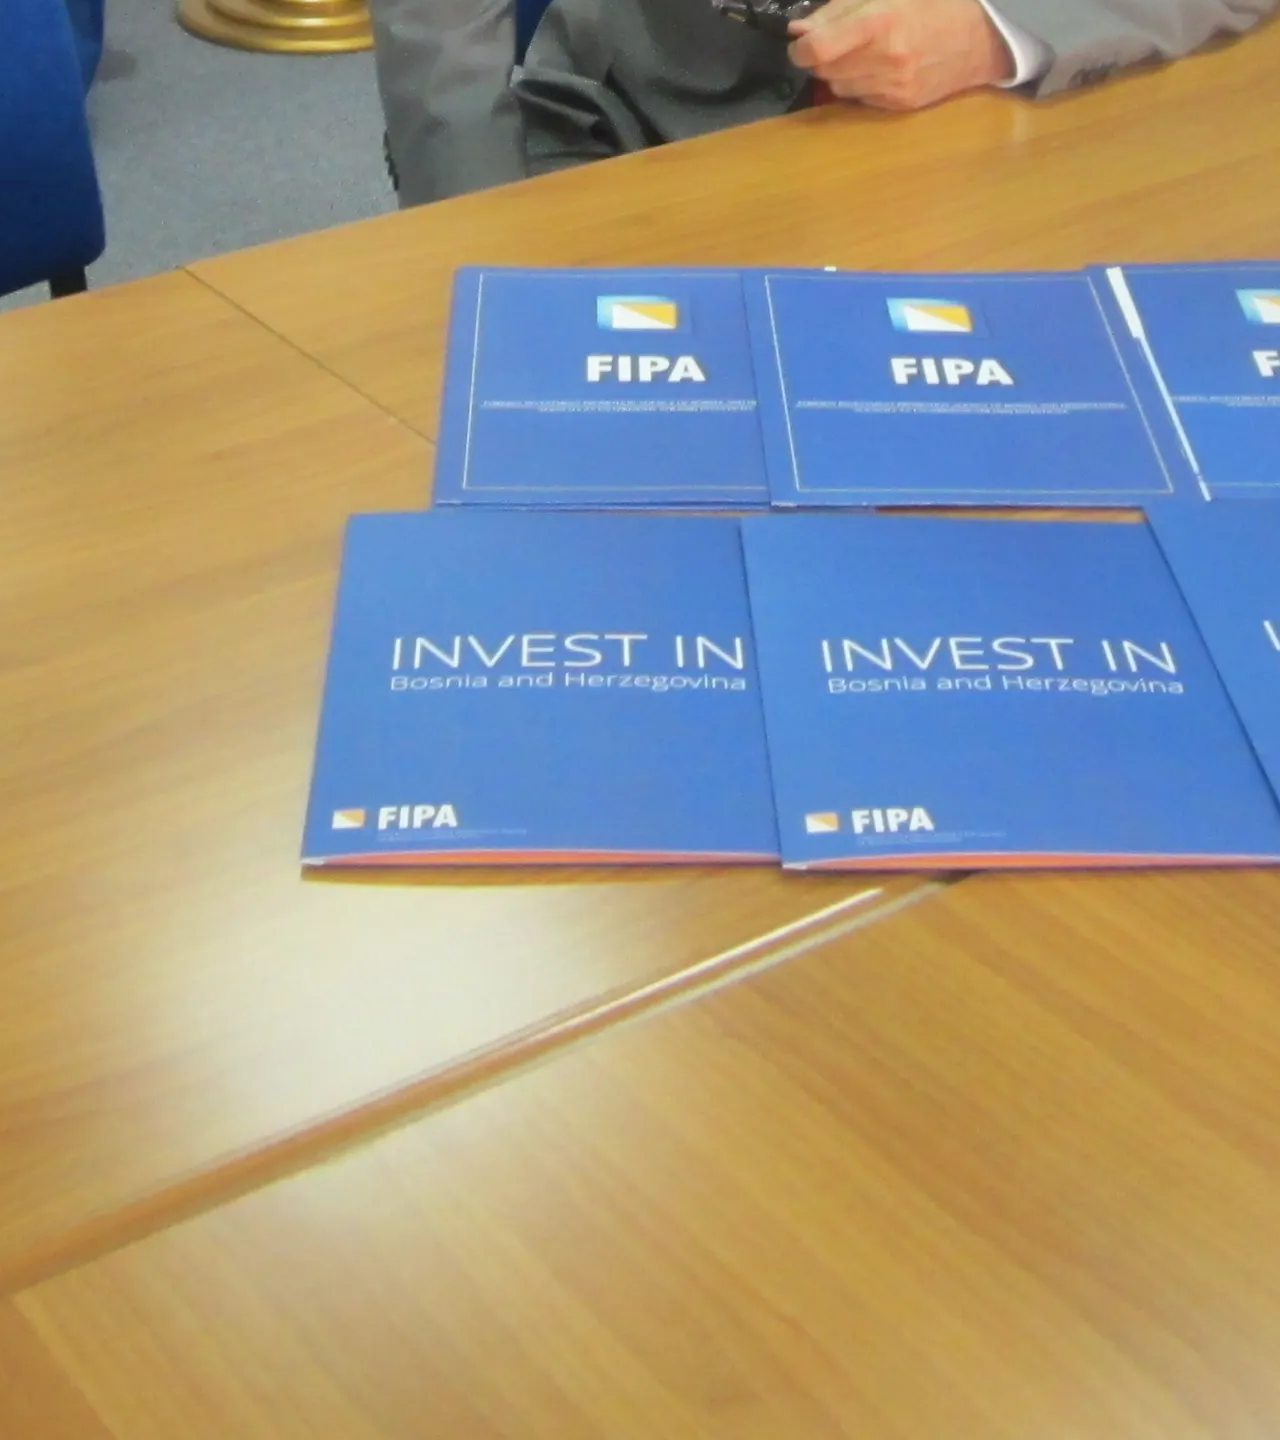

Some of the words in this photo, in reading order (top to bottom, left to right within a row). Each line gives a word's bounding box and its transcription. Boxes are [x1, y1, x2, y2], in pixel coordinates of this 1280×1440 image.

[586, 354, 706, 383] FIPA
[890, 356, 1014, 386] FIPA
[392, 633, 648, 671] INVEST
[675, 634, 743, 670] IN
[822, 636, 1074, 673] INVEST
[1101, 639, 1176, 674] IN
[390, 673, 489, 691] Bosnia
[498, 672, 553, 689] and
[564, 672, 747, 693] Herzegovina
[827, 676, 927, 695] Bosnia
[937, 674, 992, 692] and
[1002, 675, 1185, 697] Herzegovina
[377, 803, 459, 830] FIPA
[851, 806, 935, 834] FIPA
